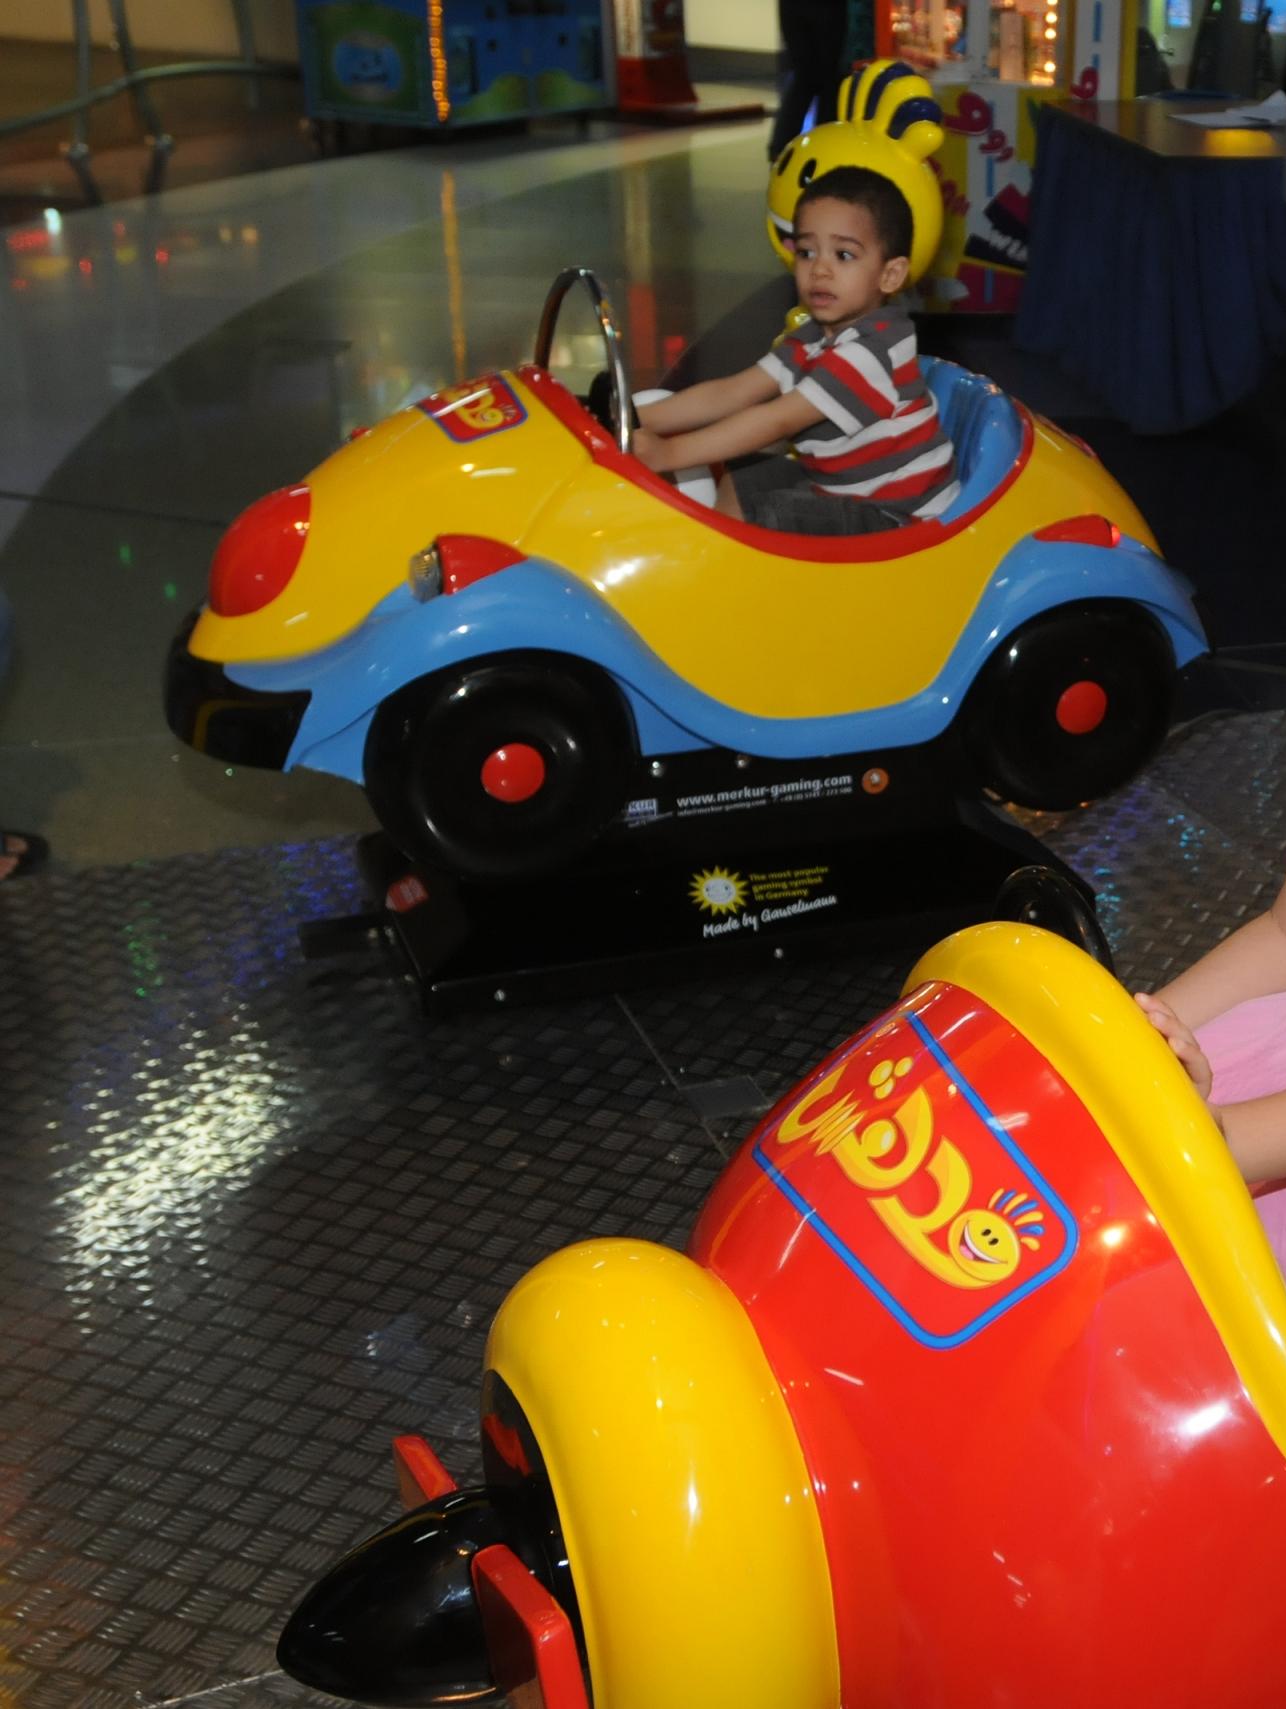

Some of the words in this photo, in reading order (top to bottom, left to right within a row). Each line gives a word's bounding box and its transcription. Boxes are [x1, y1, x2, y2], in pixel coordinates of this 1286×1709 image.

[676, 774, 853, 808] www.merkur-gaming.com
[749, 872, 767, 882] The
[768, 869, 791, 880] most
[794, 865, 829, 879] popular
[751, 880, 788, 894] gaming
[789, 876, 823, 890] symbol
[765, 888, 809, 901] Germany
[702, 915, 741, 939] Made
[742, 911, 759, 932] by
[760, 894, 838, 923] Gauselmann
